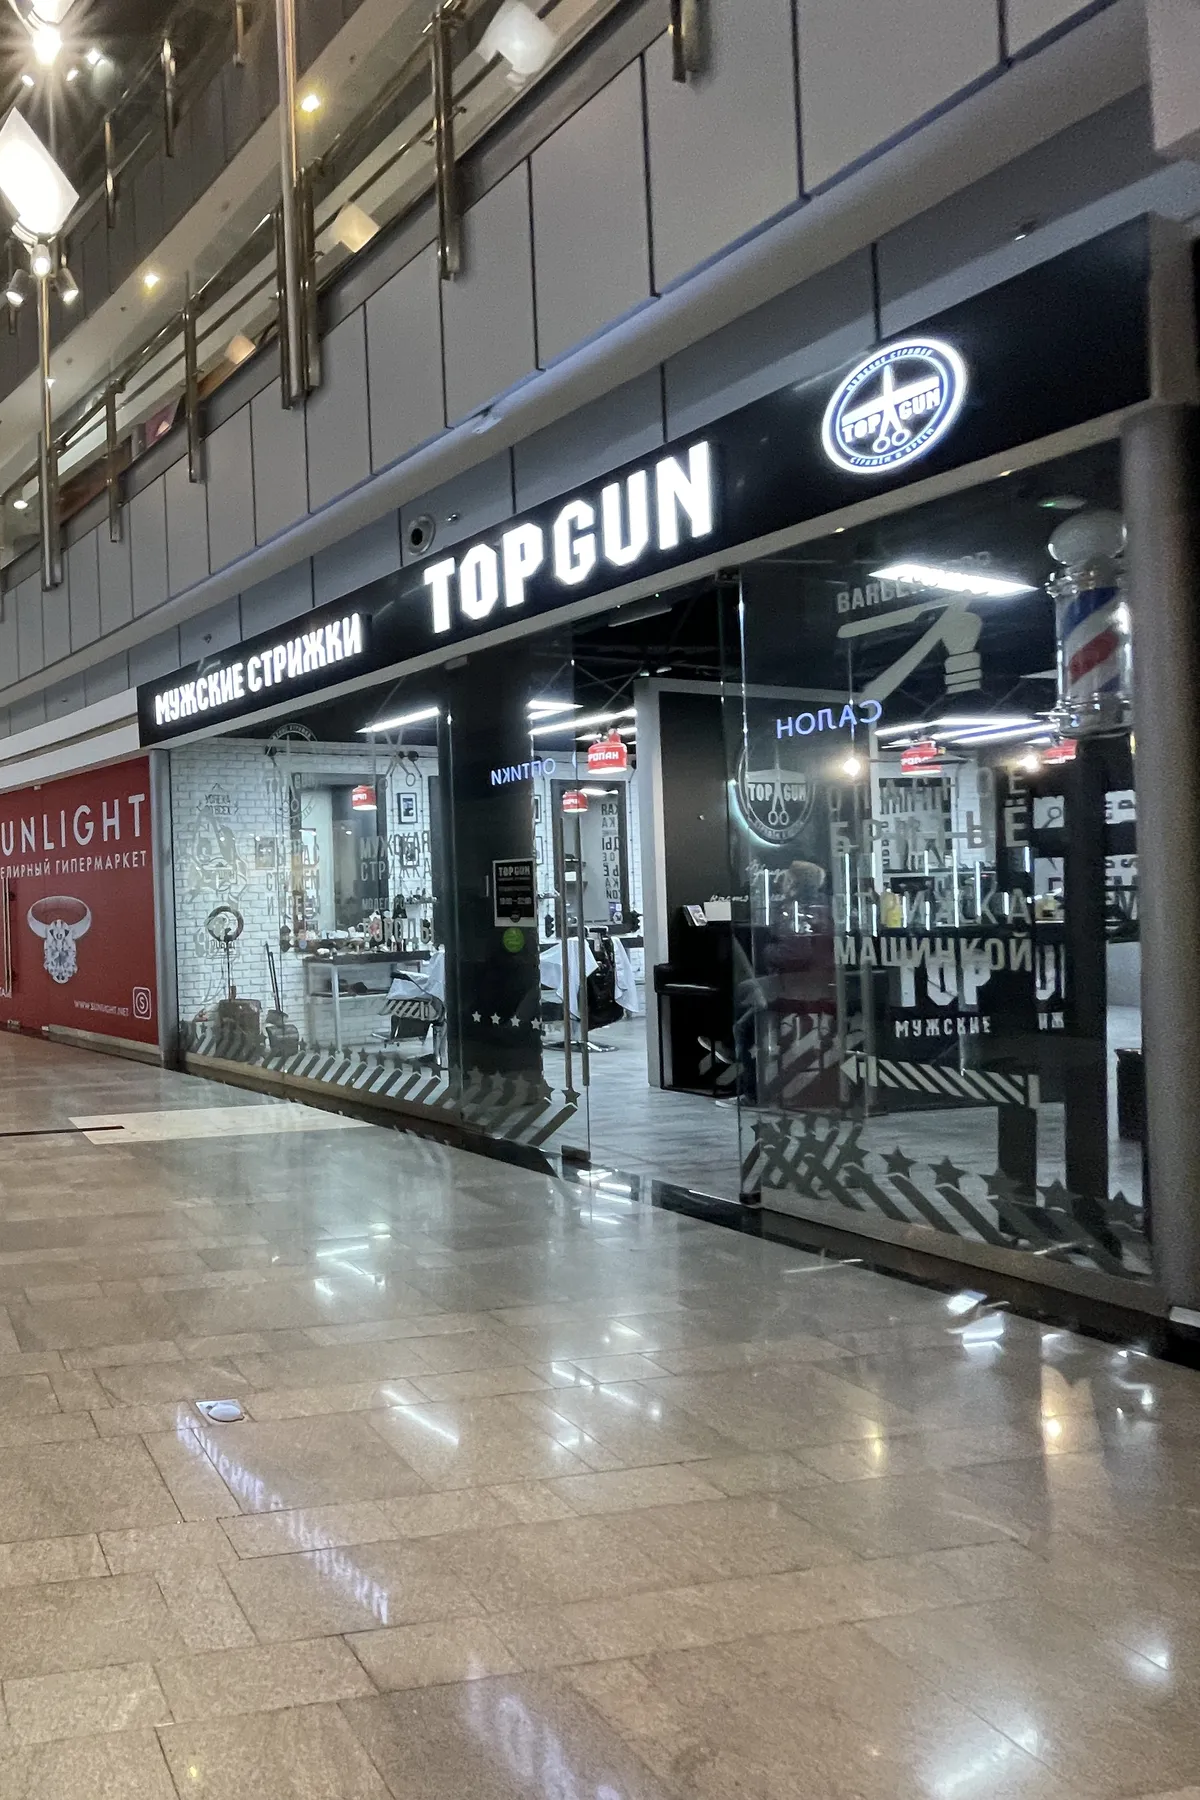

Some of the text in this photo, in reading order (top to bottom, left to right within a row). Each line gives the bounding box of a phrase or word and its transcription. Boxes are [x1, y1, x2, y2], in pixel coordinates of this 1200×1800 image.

[841, 387, 942, 444] TOP GUN
[154, 612, 363, 726] МУЖСКИЕ СТРИЖКИ
[360, 830, 431, 860] МУЖСКАЯ
[55, 850, 147, 875] ГИПЕРМАРКЕТ
[363, 917, 435, 944] БОРОДЫ
[834, 931, 1033, 972] МАШИНКОЙ
[895, 1015, 991, 1038] МУЖСКИЕ
